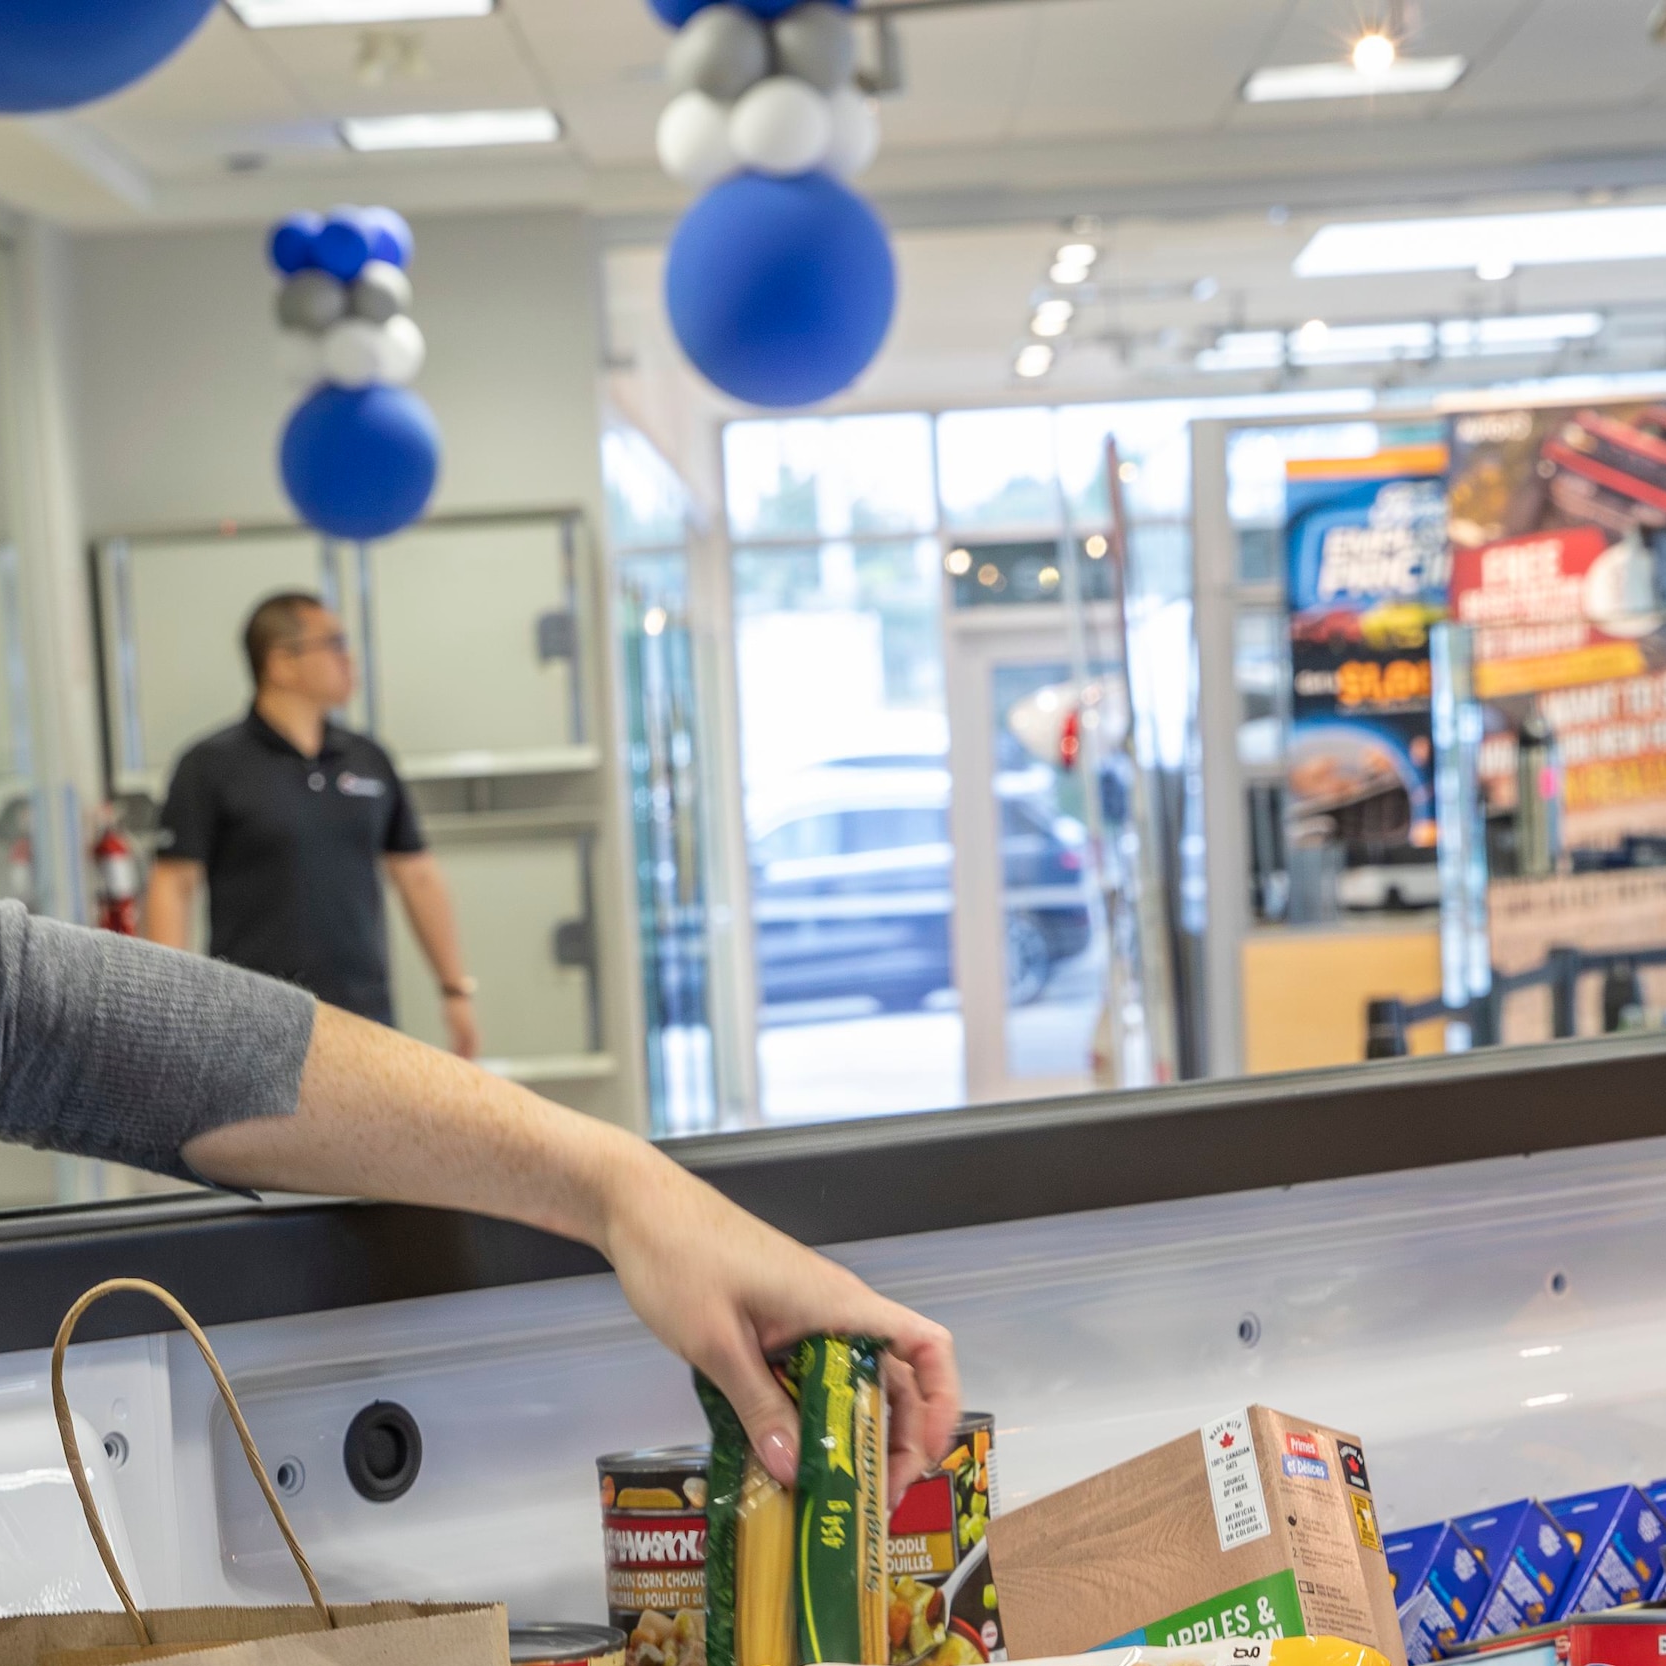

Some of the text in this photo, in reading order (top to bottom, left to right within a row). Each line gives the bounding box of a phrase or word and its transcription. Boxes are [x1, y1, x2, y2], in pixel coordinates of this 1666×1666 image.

[1209, 1419, 1243, 1440] MADE WITH
[1225, 1446, 1250, 1461] CANADIAN
[1290, 1437, 1317, 1455] Primes
[1225, 1461, 1238, 1471] OATS
[1298, 1459, 1326, 1479] Délices
[1223, 1474, 1245, 1488] SOURCE
[1224, 1482, 1249, 1497] OF FIBRE
[1234, 1501, 1244, 1509] NO
[1225, 1506, 1257, 1523] ARTIFICIAL
[1228, 1515, 1258, 1532] FLAVOURS
[1235, 1523, 1263, 1538] COLOURS
[637, 1573, 663, 1588] CORN
[646, 1593, 681, 1608] POULET
[1165, 1603, 1251, 1648] APPLES
[1256, 1595, 1276, 1625] &
[1234, 1645, 1261, 1659] g
